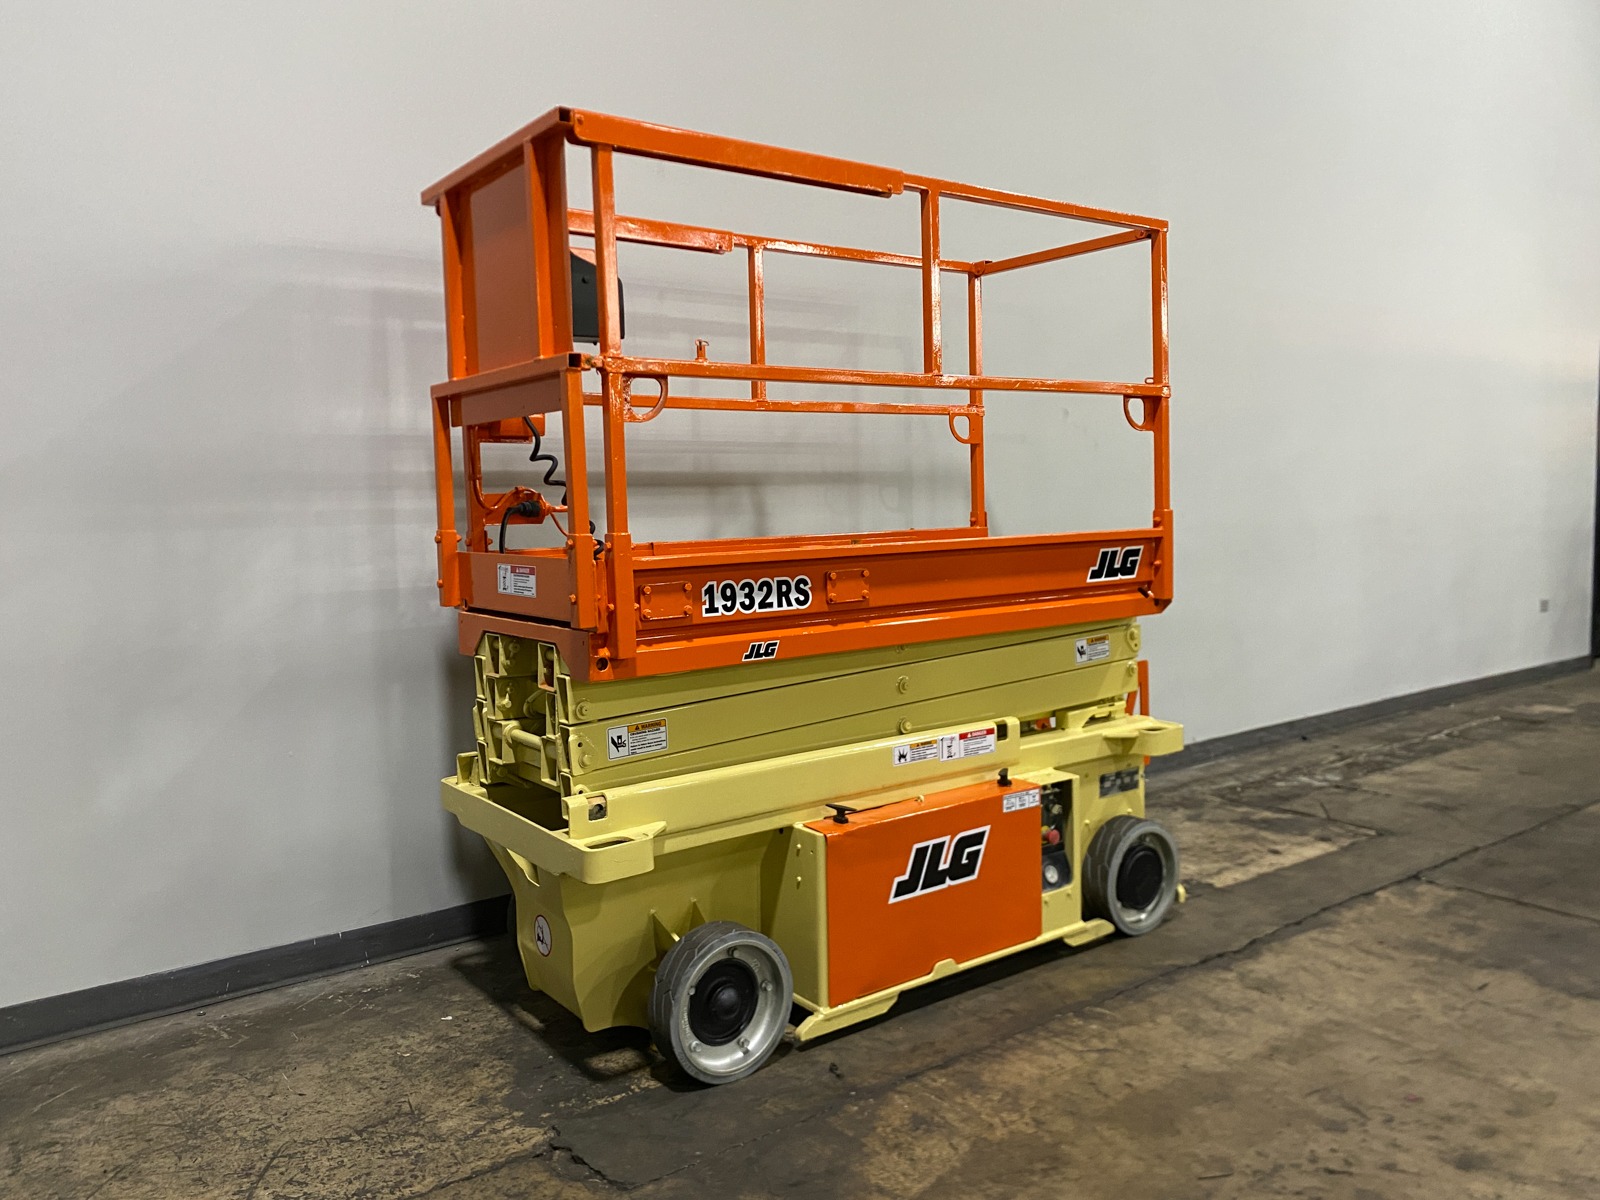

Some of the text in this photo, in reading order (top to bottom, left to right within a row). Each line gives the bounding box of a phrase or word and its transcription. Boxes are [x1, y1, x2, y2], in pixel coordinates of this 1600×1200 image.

[1088, 547, 1142, 580] JLG
[703, 577, 811, 615] 1932RS
[743, 641, 778, 660] JLG
[892, 828, 988, 900] JLG
